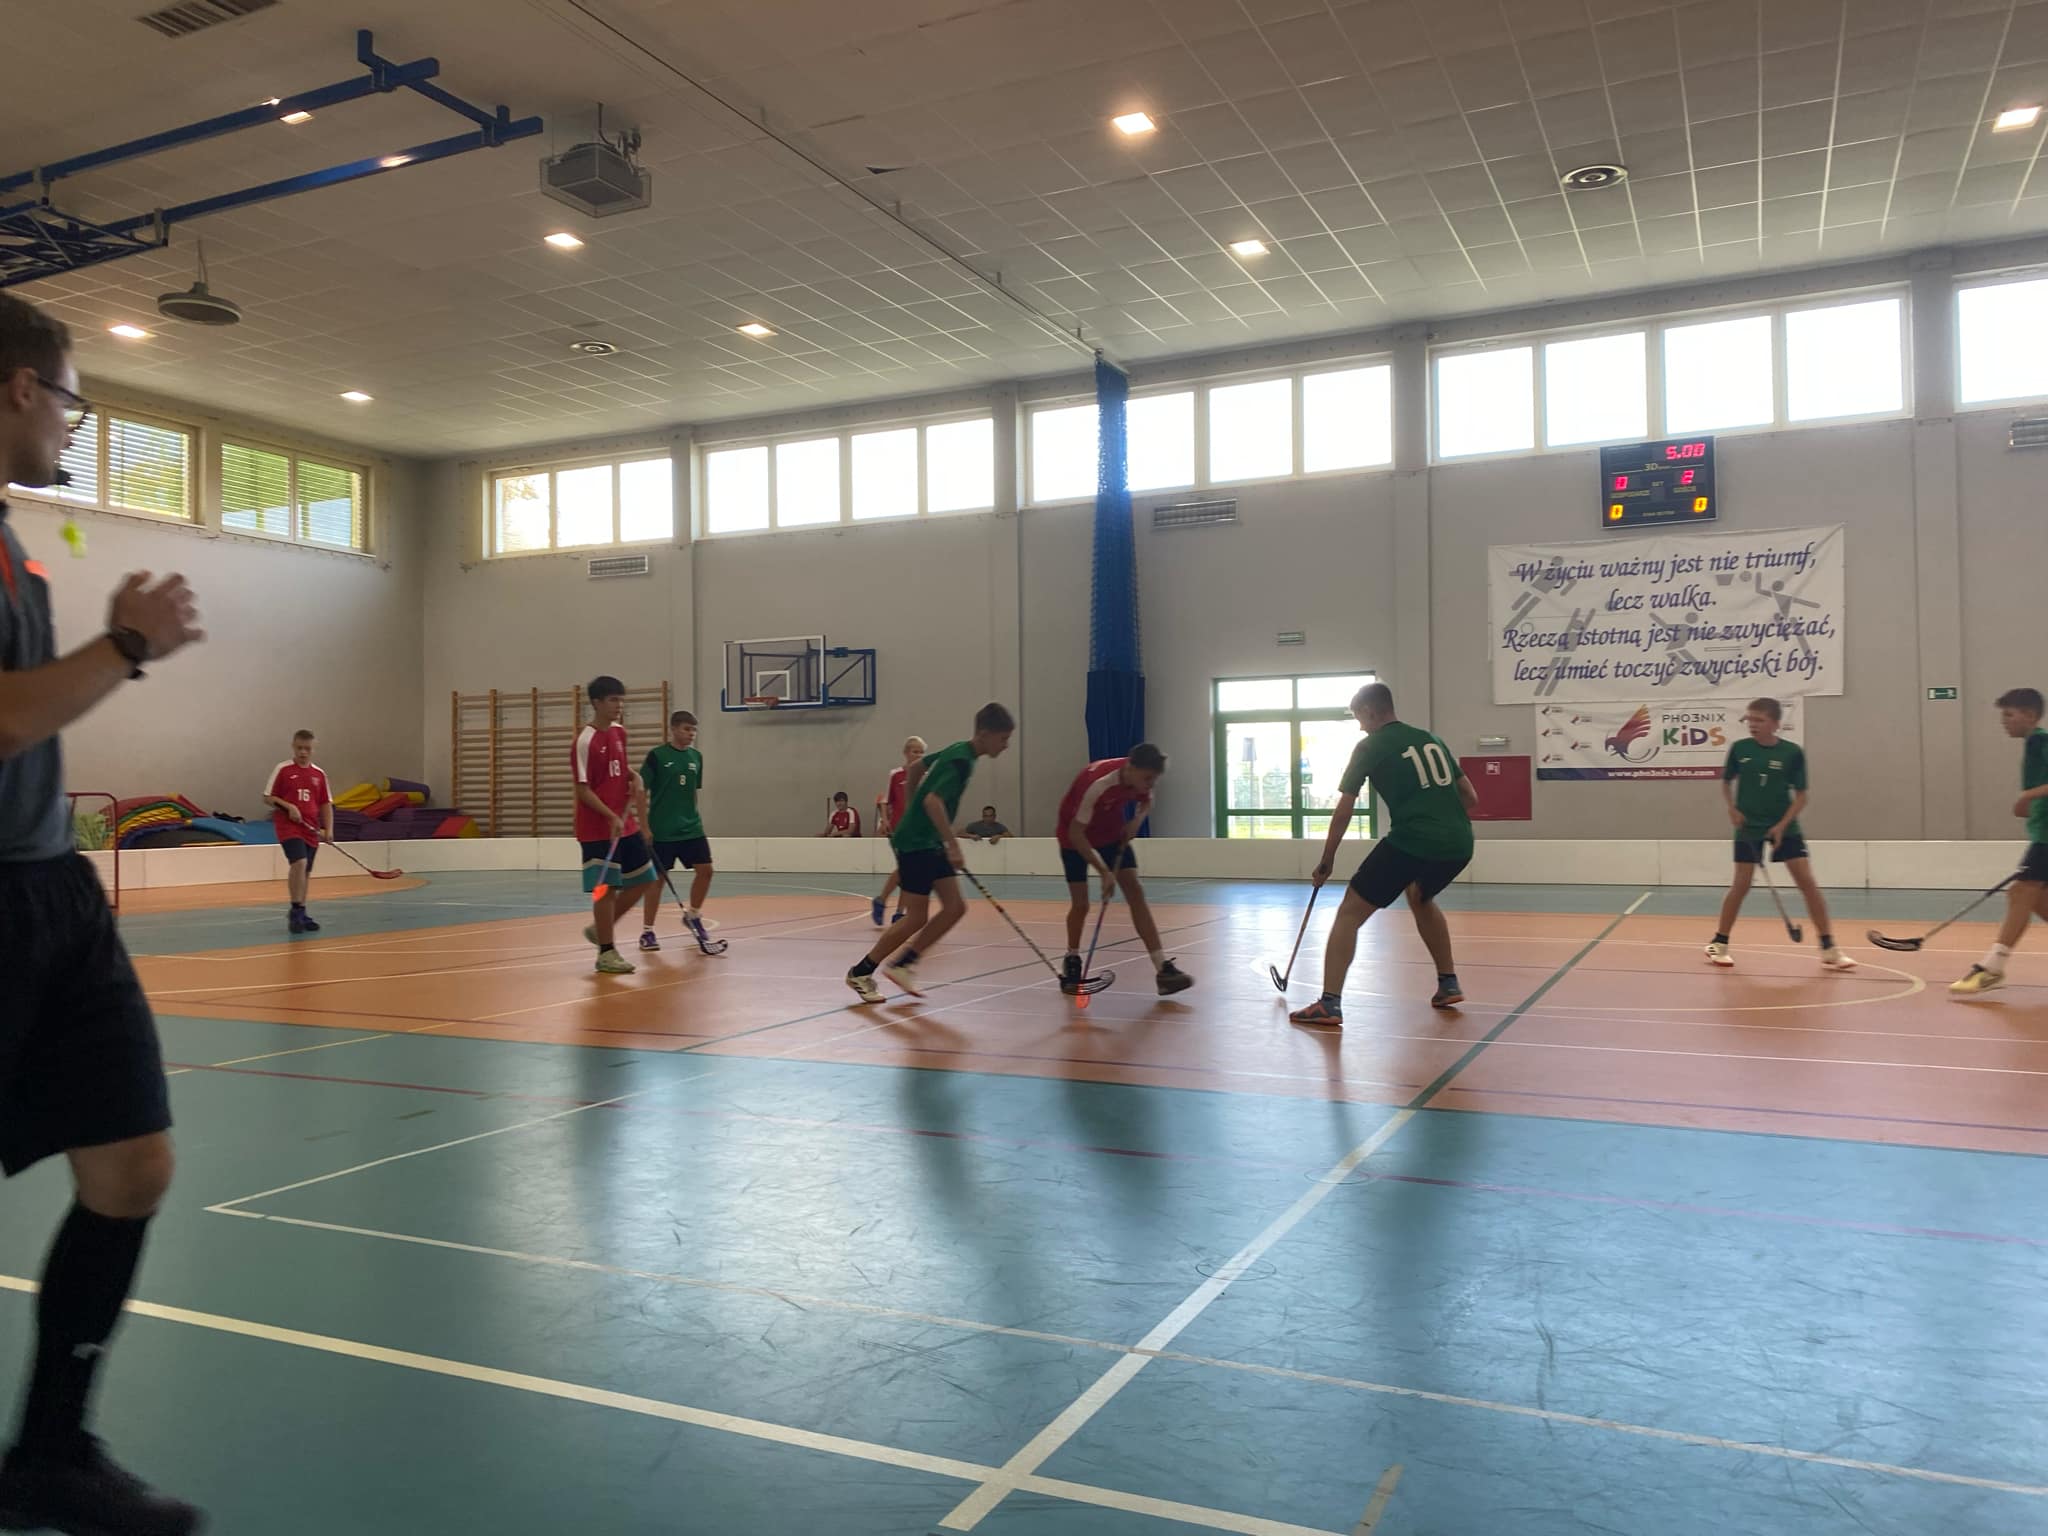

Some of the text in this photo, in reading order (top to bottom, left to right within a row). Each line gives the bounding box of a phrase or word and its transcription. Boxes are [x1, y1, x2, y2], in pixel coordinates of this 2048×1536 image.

[1681, 469, 1695, 485] 2
[1610, 504, 1624, 520] 0
[1694, 497, 1709, 513] 0
[1516, 542, 1816, 588] W życiu ważny jest nie triumf,
[1607, 584, 1717, 612] lecz walka.
[1502, 614, 1836, 652] Rzeczą istotną jest nie zwyciężać,
[1513, 648, 1823, 686] lecz umieć toczyć zwycięski bój.
[608, 759, 621, 777] 18
[1401, 743, 1452, 789] 10
[679, 774, 686, 786] 8
[297, 788, 311, 802] 16
